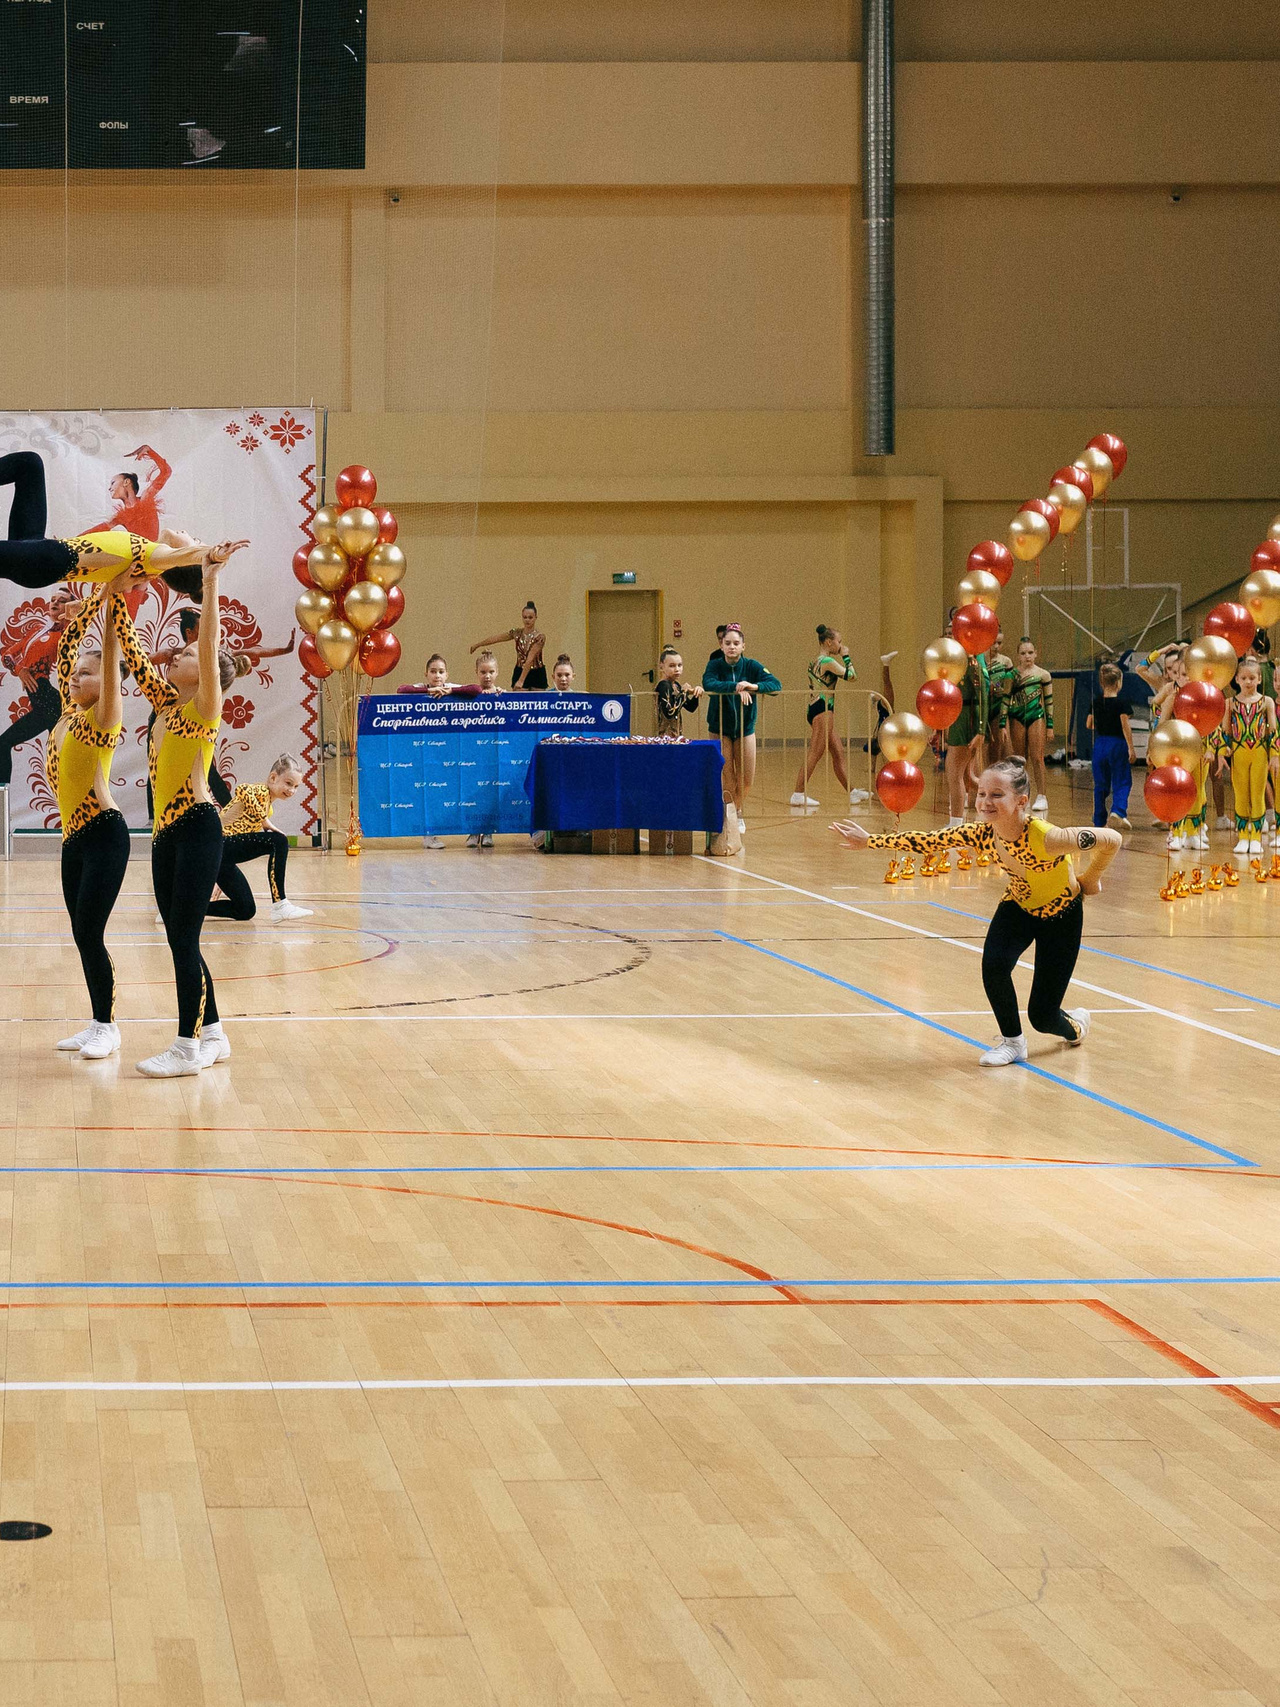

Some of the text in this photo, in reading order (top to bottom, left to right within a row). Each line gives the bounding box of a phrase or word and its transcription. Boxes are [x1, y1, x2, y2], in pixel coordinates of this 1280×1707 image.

[76, 22, 105, 30] СЧЕТ
[9, 96, 49, 104] ВРЕМЯ
[99, 121, 129, 130] ФОЛЫ
[376, 701, 593, 714] ЦЕНТР СПОРТИВНОГО РАЗВИТИЯ «СТАРТ»
[372, 713, 596, 731] Спортивная аэробика Гимнастика
